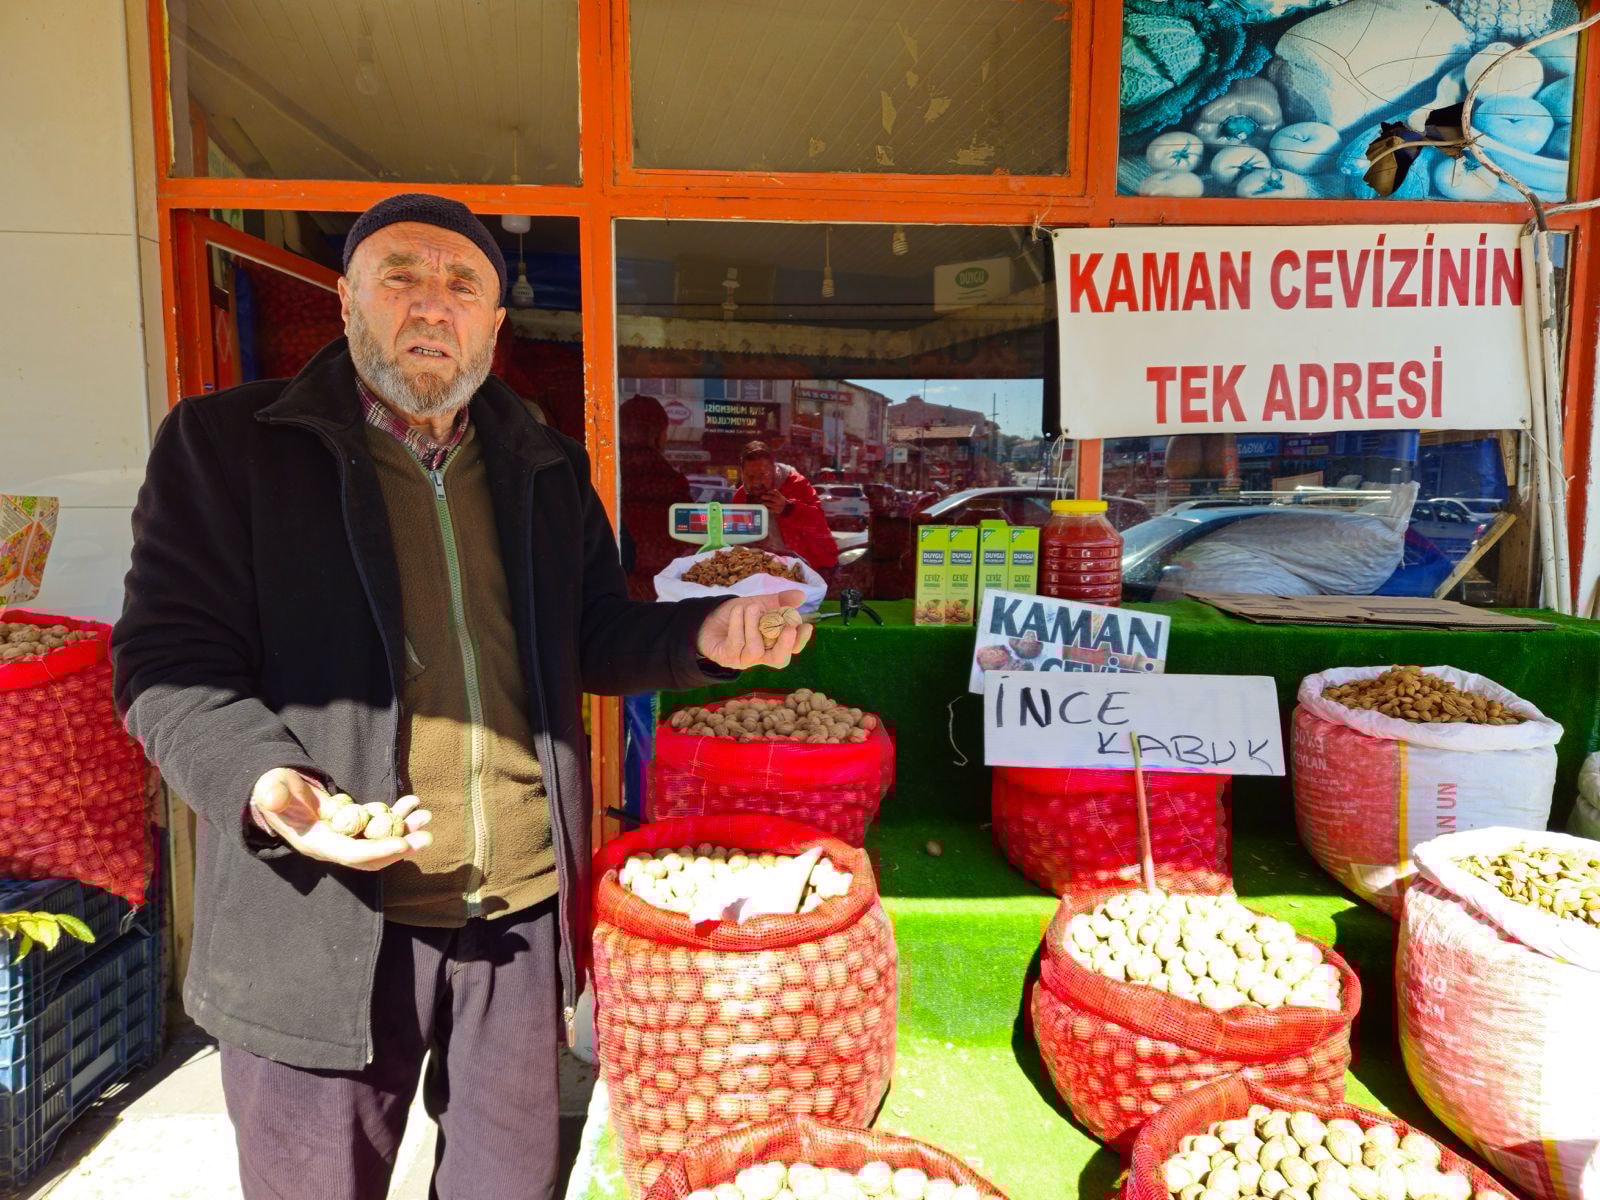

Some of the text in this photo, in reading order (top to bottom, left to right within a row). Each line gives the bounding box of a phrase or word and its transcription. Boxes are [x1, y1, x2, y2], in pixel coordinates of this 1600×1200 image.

[1069, 232, 1522, 314] KAMAN CEVİZİNİN
[1146, 346, 1443, 424] TEK ADRESİ
[990, 596, 1162, 659] KAMAN
[996, 675, 1130, 728] İNCE
[1097, 731, 1274, 775] KABUK
